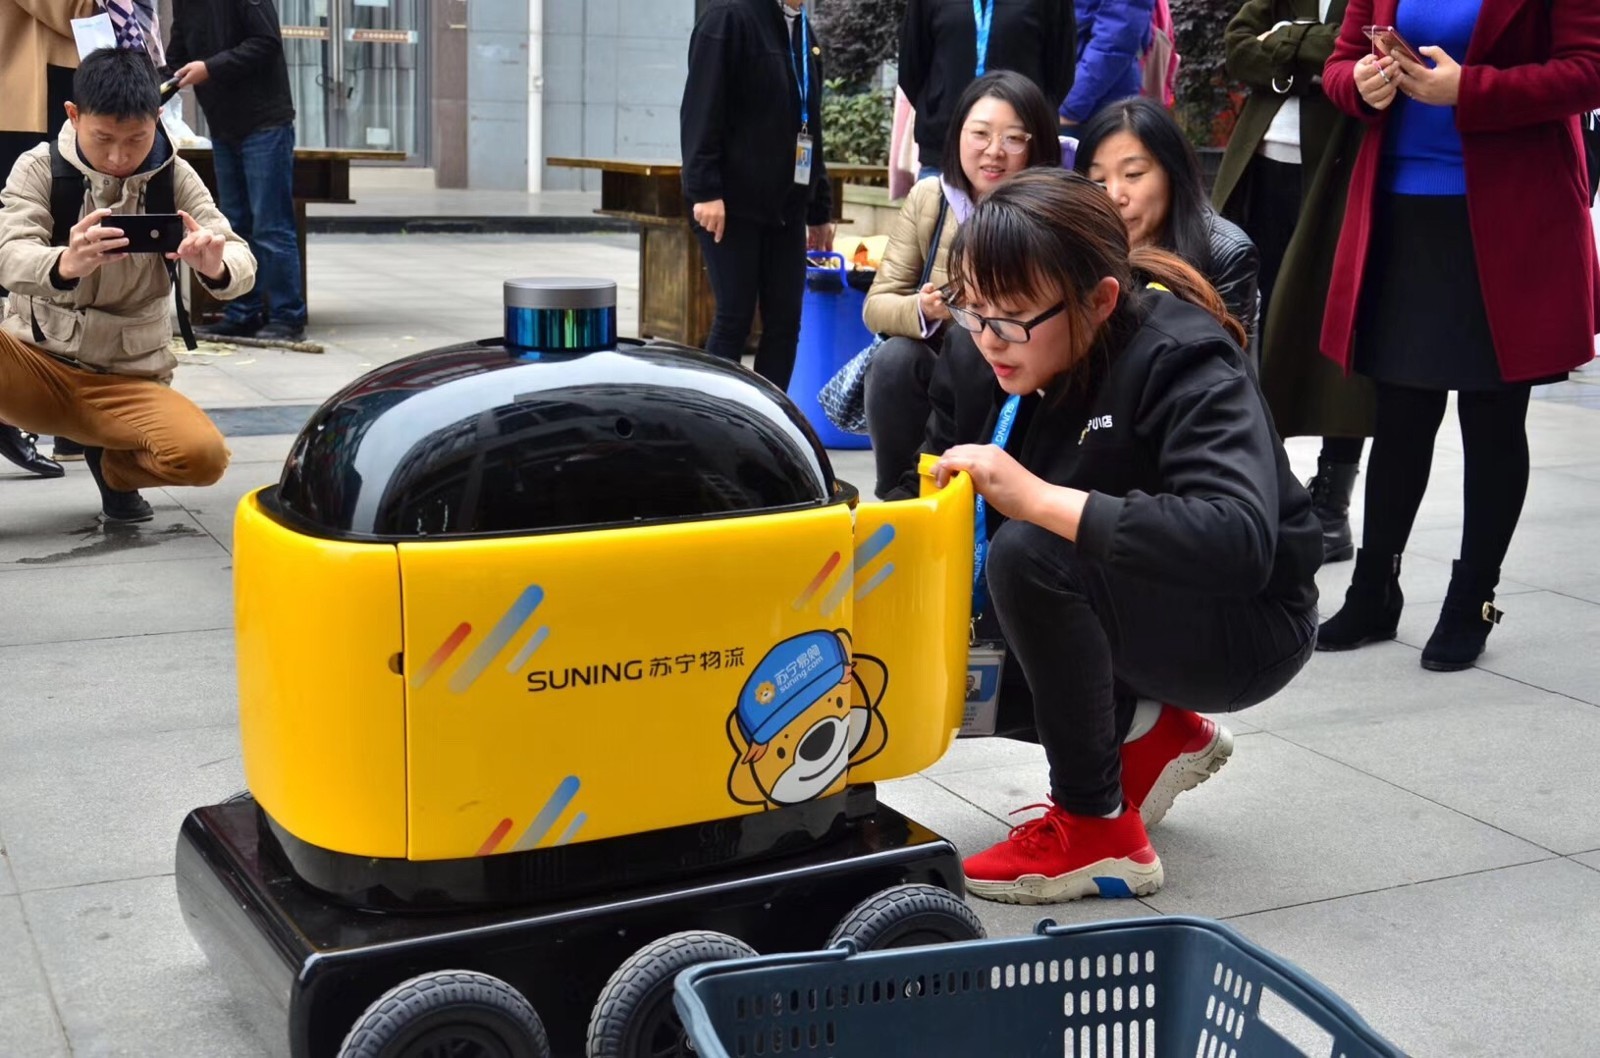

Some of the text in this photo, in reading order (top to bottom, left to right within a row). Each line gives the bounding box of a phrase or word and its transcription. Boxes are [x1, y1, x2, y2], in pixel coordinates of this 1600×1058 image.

[995, 403, 1015, 442] SUNING
[527, 646, 746, 692] SUNING 苏宁物流
[773, 643, 821, 687] 苏宁易购
[779, 655, 824, 694] suning.com
